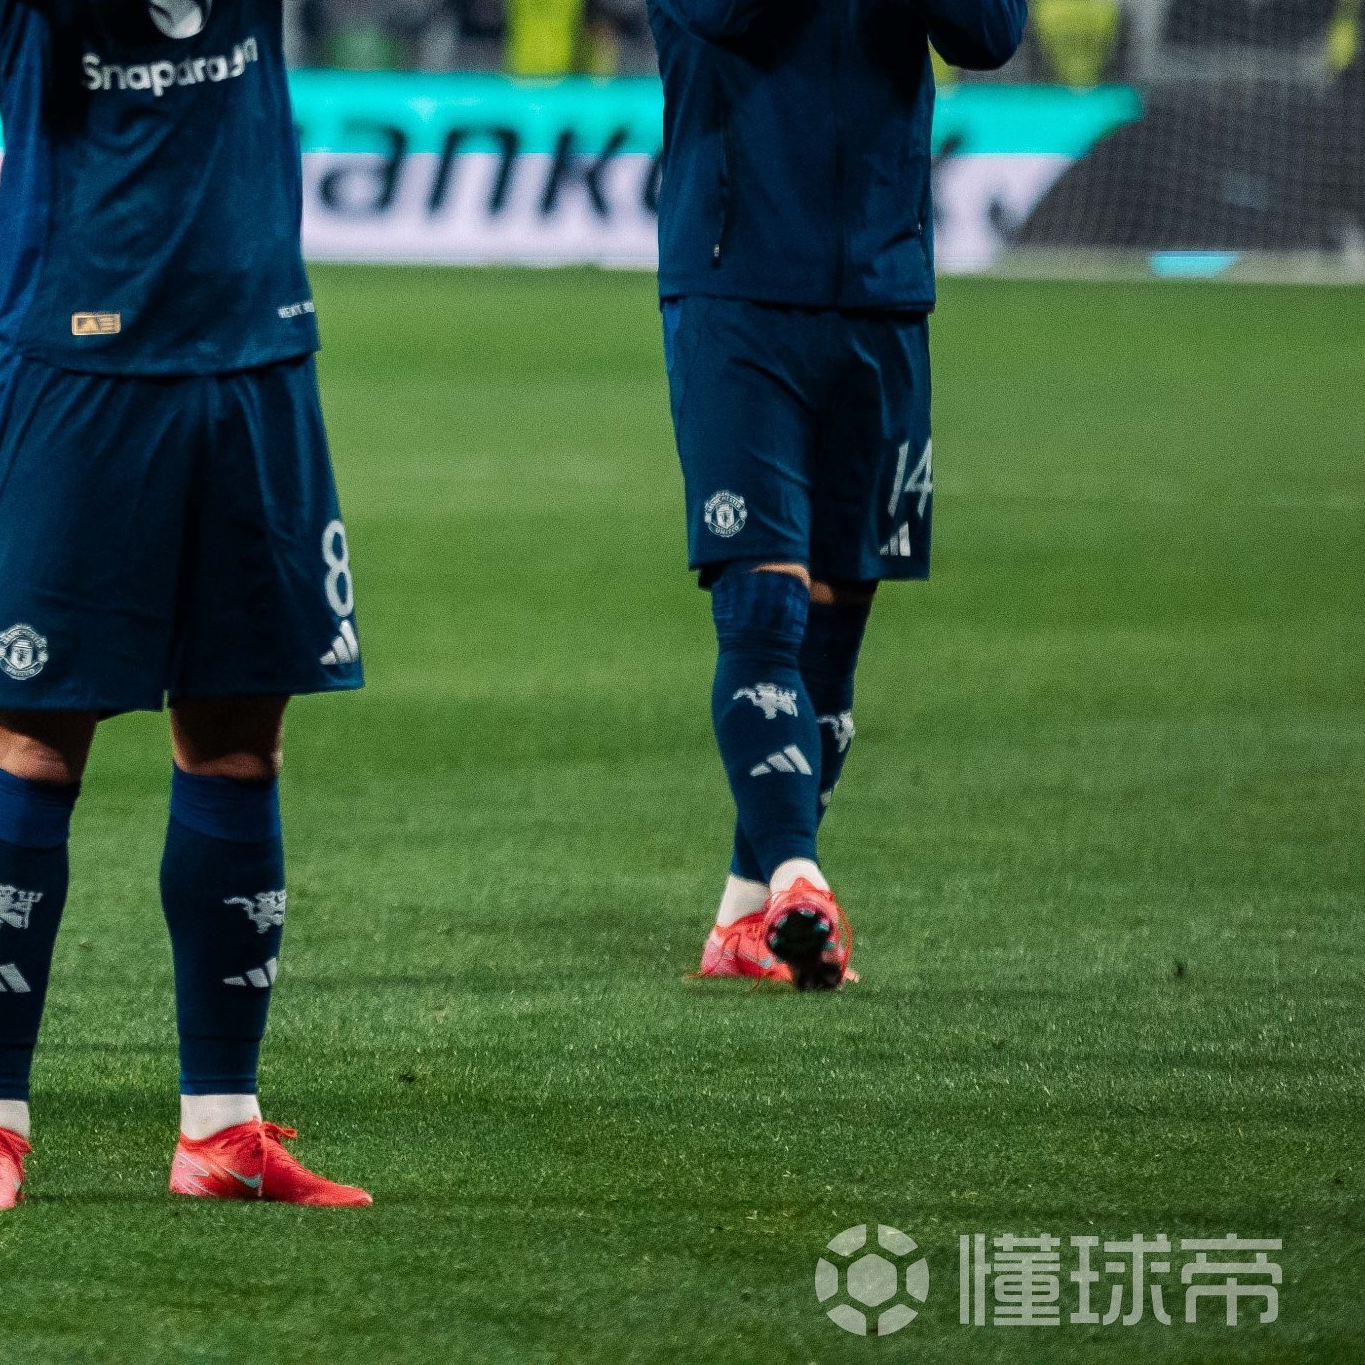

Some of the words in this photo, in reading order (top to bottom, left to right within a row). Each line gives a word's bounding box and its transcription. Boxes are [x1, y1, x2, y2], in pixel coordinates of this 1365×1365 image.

[81, 36, 259, 97] Snapdragn
[316, 126, 662, 218] ank
[887, 437, 934, 520] 14
[321, 519, 355, 618] 8
